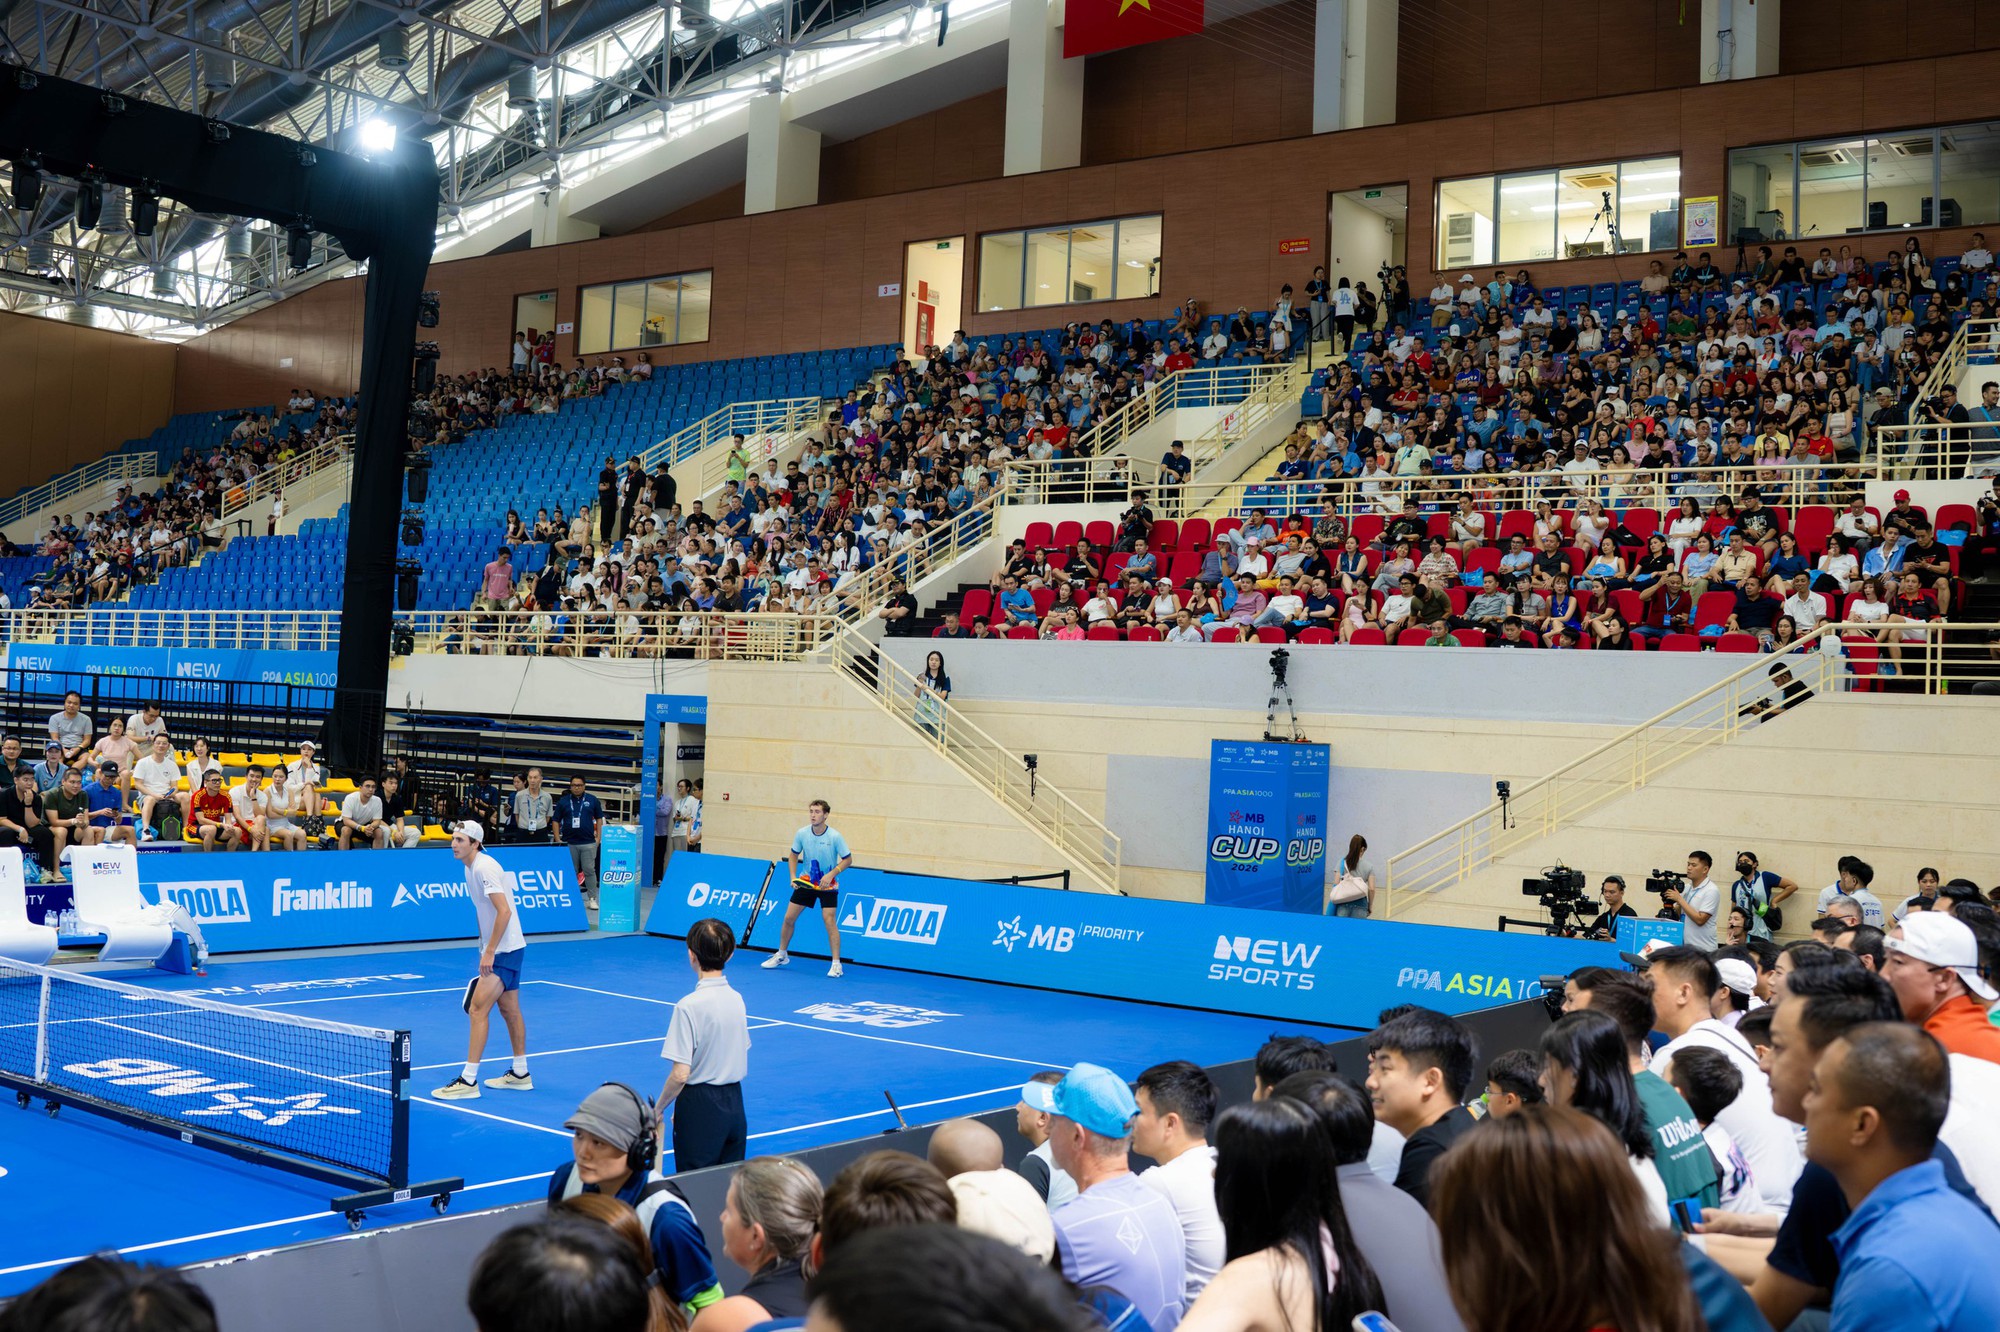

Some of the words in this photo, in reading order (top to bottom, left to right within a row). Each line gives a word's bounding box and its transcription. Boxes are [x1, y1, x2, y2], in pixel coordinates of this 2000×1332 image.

[883, 286, 888, 295] 3
[15, 656, 52, 670] NEW
[176, 662, 221, 678] NEW
[14, 672, 52, 682] SPORTS
[262, 671, 282, 684] PPA
[284, 672, 314, 686] ASIA
[315, 673, 337, 687] 100
[1255, 790, 1273, 798] 1000
[1245, 813, 1265, 824] MB
[1306, 814, 1316, 825] MB
[1228, 824, 1264, 836] HANOI
[1296, 828, 1316, 837] HANOI
[1211, 835, 1280, 862] CUP
[1287, 838, 1323, 864] CUP
[1231, 863, 1258, 873] 2026
[603, 871, 633, 883] CUP
[415, 882, 470, 899] KAIWI
[709, 889, 740, 907] FPT
[515, 893, 572, 909] PORTS
[871, 905, 939, 940] JOOLA
[1029, 924, 1076, 953] MB
[1083, 924, 1144, 942] PRIORITY
[1213, 935, 1322, 969] NEW
[251, 973, 425, 991] SPORTS
[1208, 964, 1316, 991] SPORTS
[1397, 967, 1442, 992] PPA
[1445, 973, 1513, 999] ASIA
[1656, 1115, 1702, 1149] Wilso
[395, 1190, 410, 1200] JOOLA
